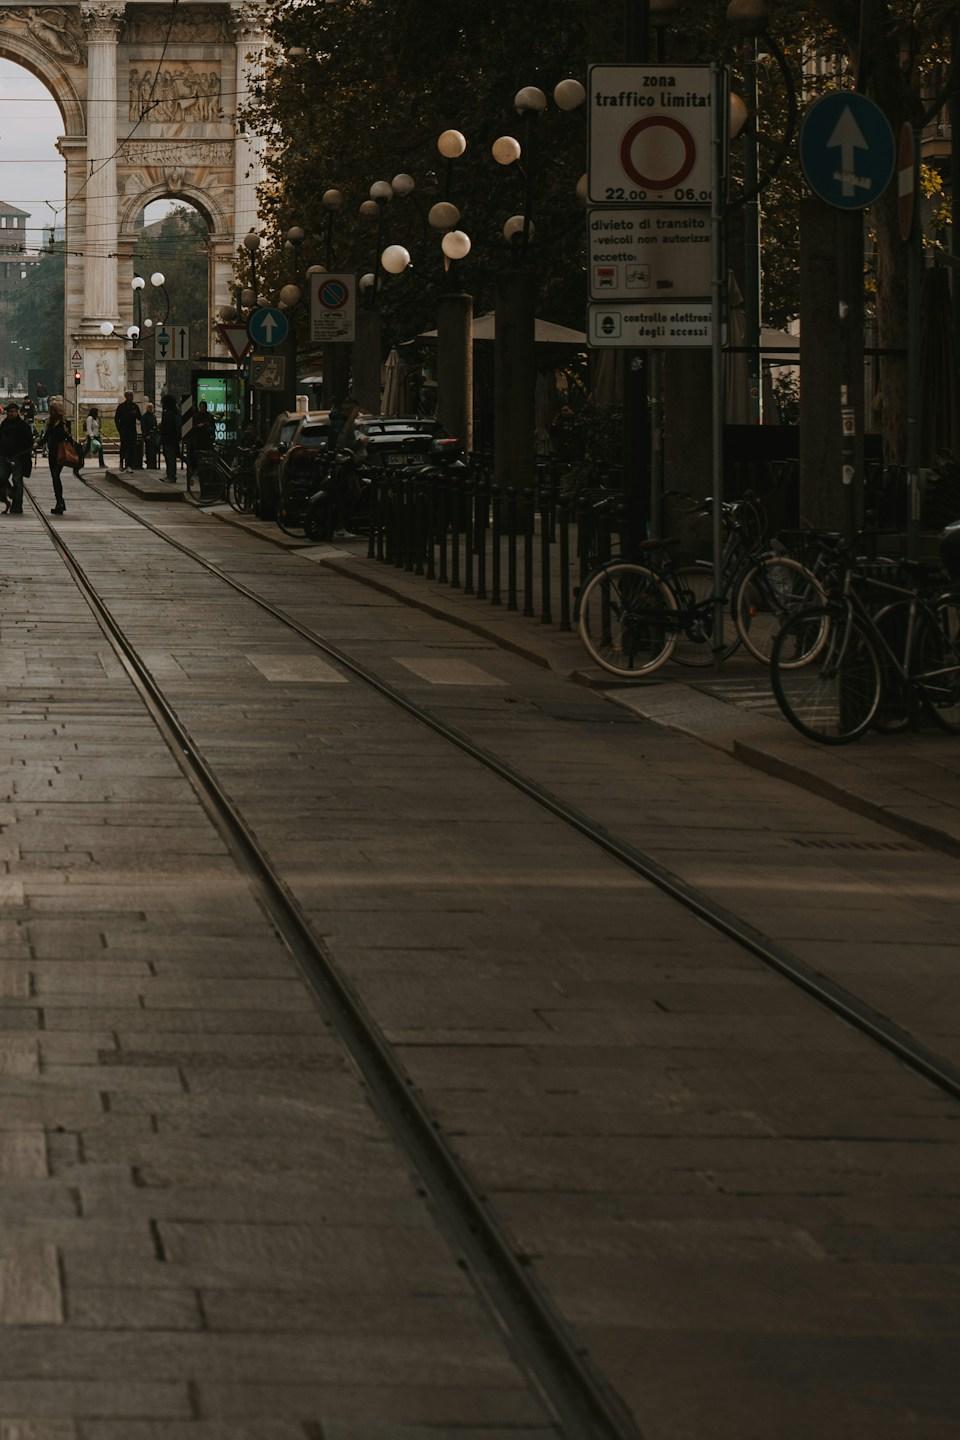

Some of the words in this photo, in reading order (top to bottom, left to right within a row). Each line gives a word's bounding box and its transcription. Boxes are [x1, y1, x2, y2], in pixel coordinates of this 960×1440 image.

[643, 75, 676, 87] zona
[596, 91, 655, 107] traffico
[660, 92, 711, 107] limitat
[605, 188, 647, 201] 22.00
[591, 220, 634, 230] divieto
[639, 219, 650, 229] di
[656, 218, 705, 229] transito
[638, 236, 658, 244] non
[623, 312, 667, 322] controllo
[638, 326, 665, 338] degli
[670, 326, 708, 336] accessi
